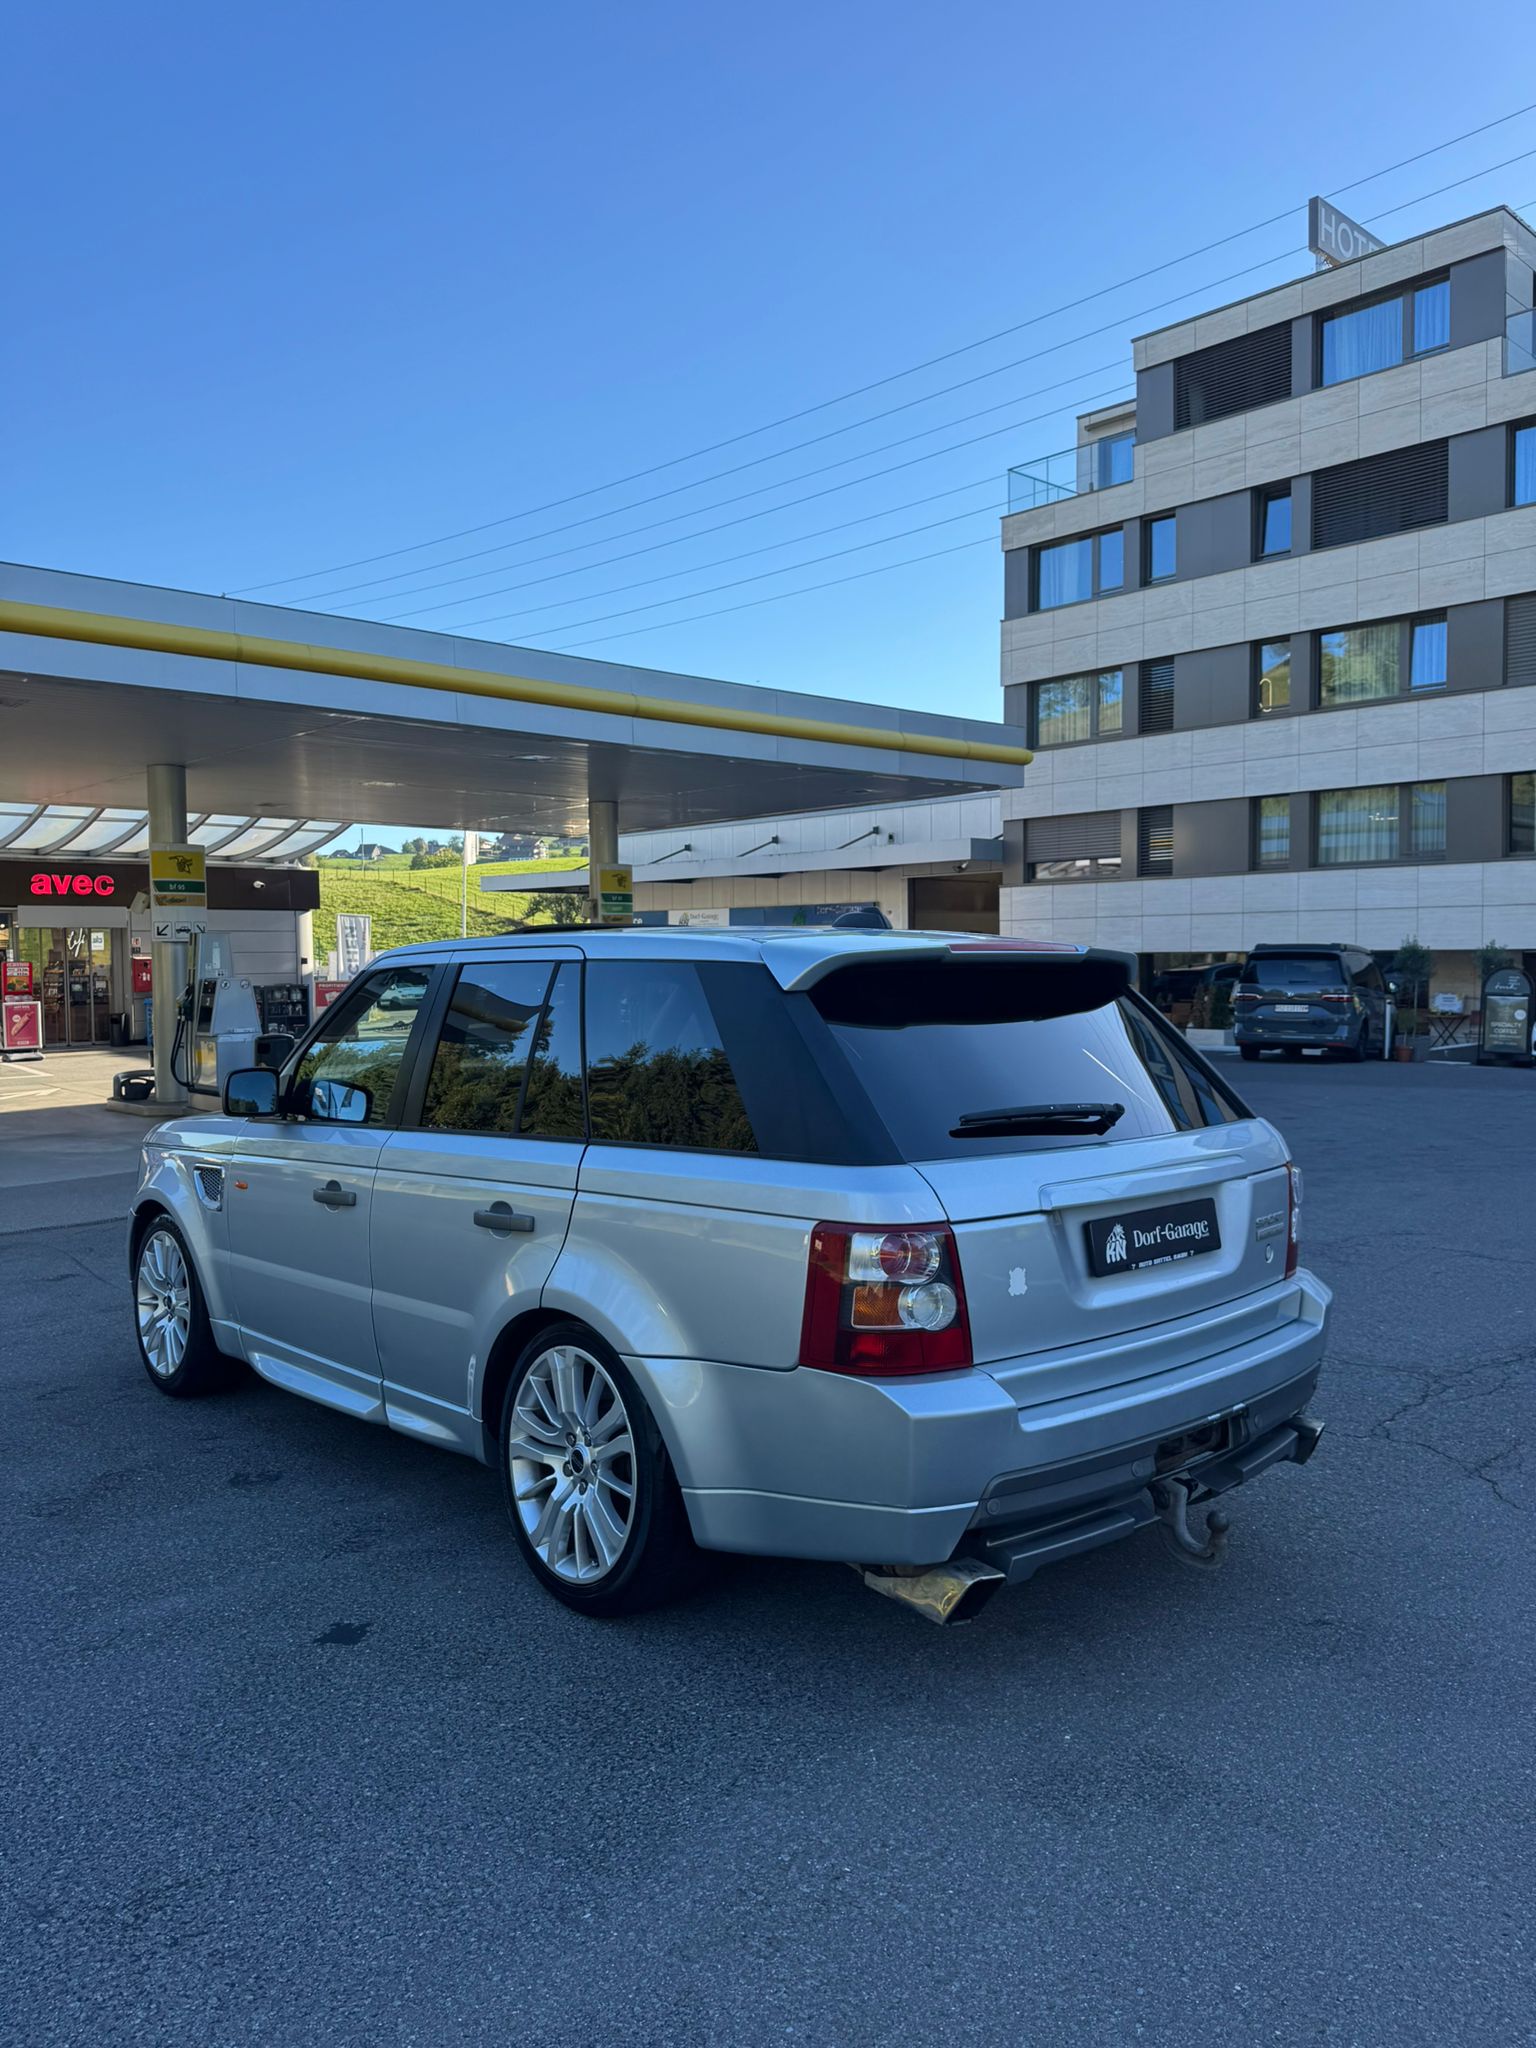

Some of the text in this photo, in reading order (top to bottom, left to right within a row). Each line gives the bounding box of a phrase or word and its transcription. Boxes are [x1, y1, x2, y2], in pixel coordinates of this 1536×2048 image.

[1321, 207, 1379, 258] HOT
[30, 873, 115, 896] avec
[345, 925, 359, 980] CHEN
[1133, 1220, 1209, 1248] Dorf-Garage
